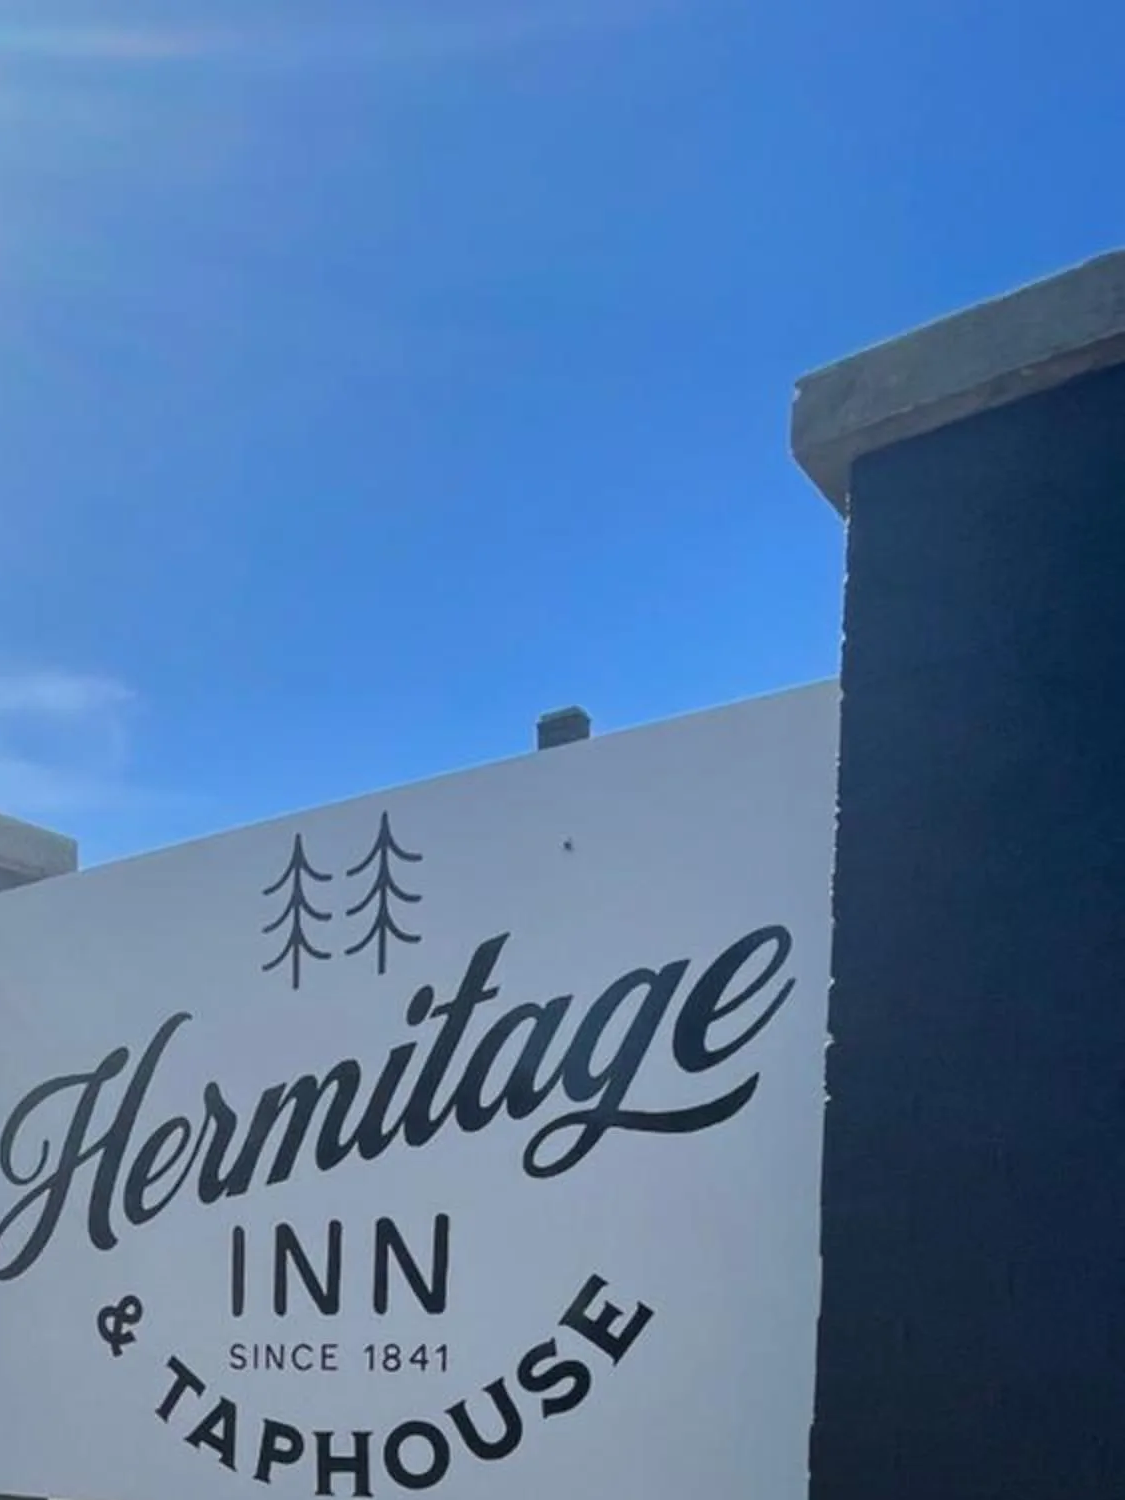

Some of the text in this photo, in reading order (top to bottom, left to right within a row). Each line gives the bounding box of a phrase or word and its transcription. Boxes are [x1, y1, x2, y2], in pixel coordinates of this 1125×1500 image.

[230, 1212, 450, 1318] INN
[96, 1273, 655, 1499] & TAPHOUSE
[228, 1342, 451, 1373] SINCE 1841
